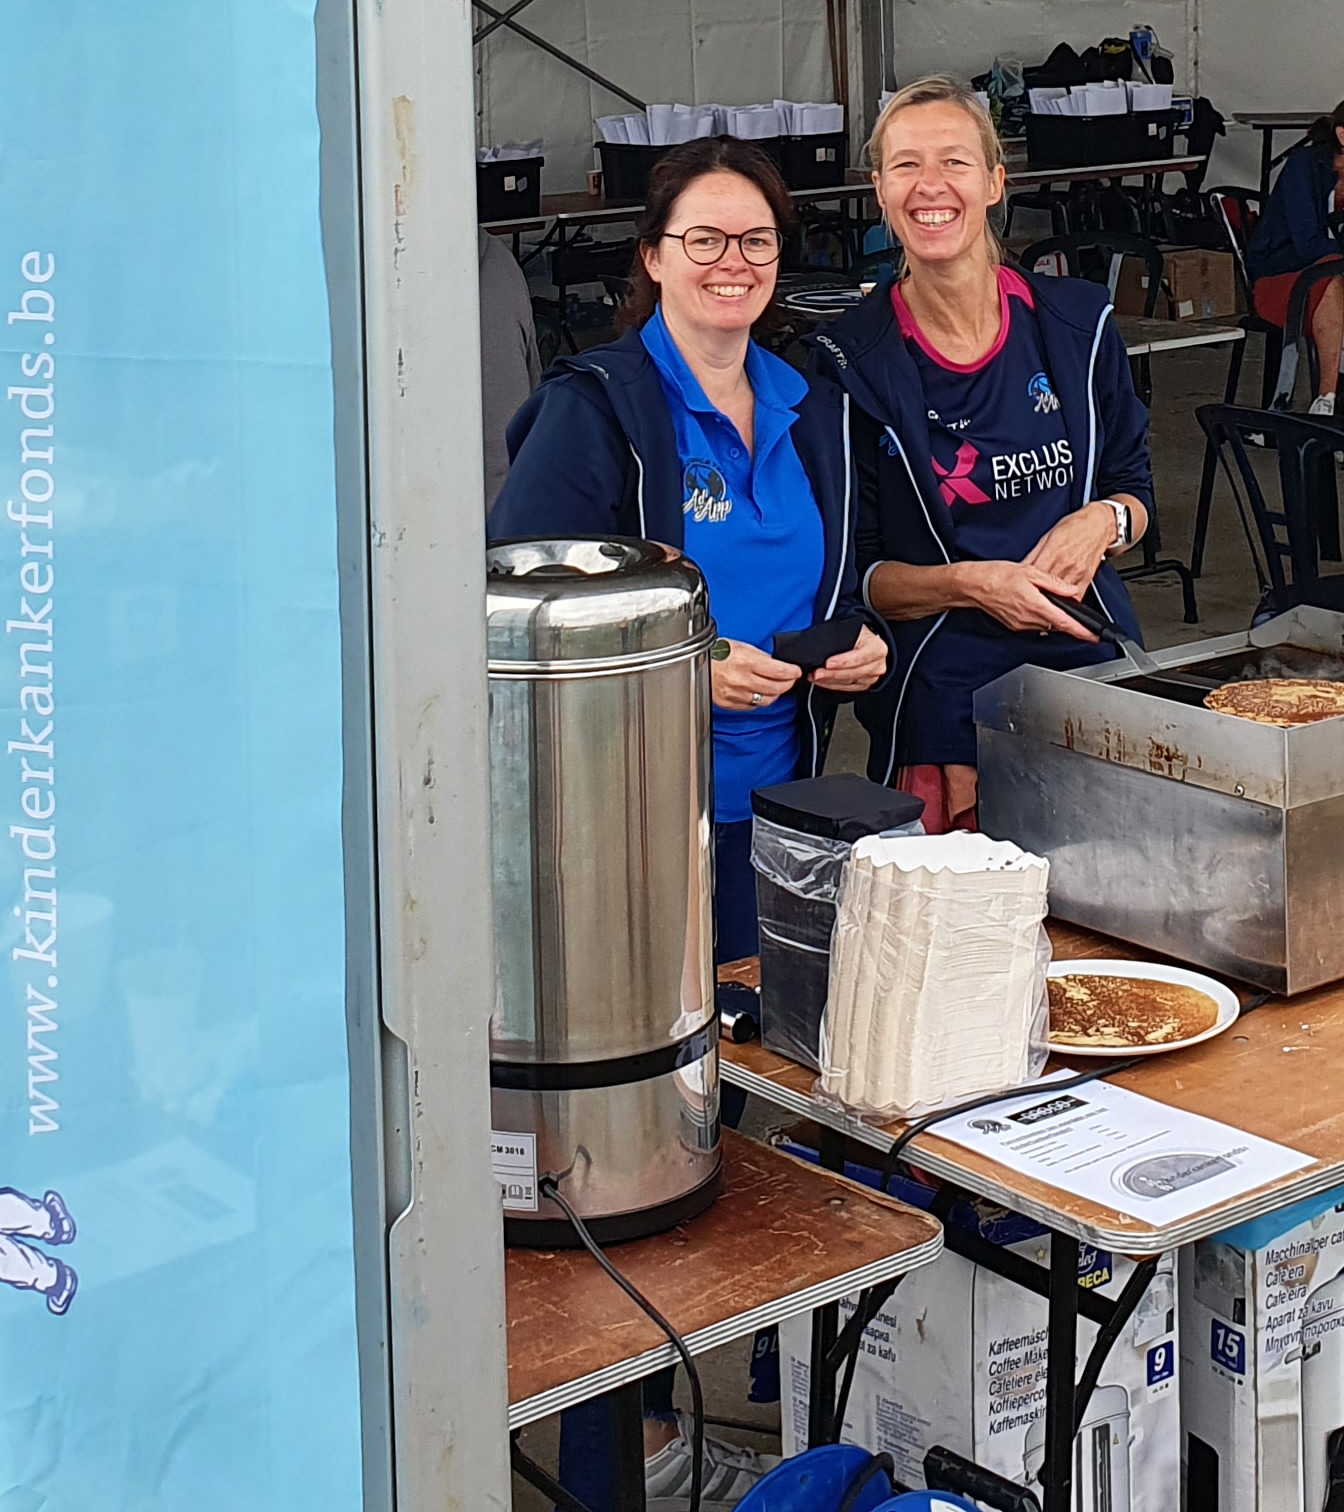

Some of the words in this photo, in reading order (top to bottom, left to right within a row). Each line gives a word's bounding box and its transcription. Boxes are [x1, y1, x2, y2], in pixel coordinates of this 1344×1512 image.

[991, 439, 1074, 481] EXCLUS
[6, 250, 59, 1137] www.kinderkankerfonds.be
[1216, 1328, 1241, 1359] 15
[988, 1355, 1022, 1377] Coffee
[1154, 1347, 1166, 1372] 9
